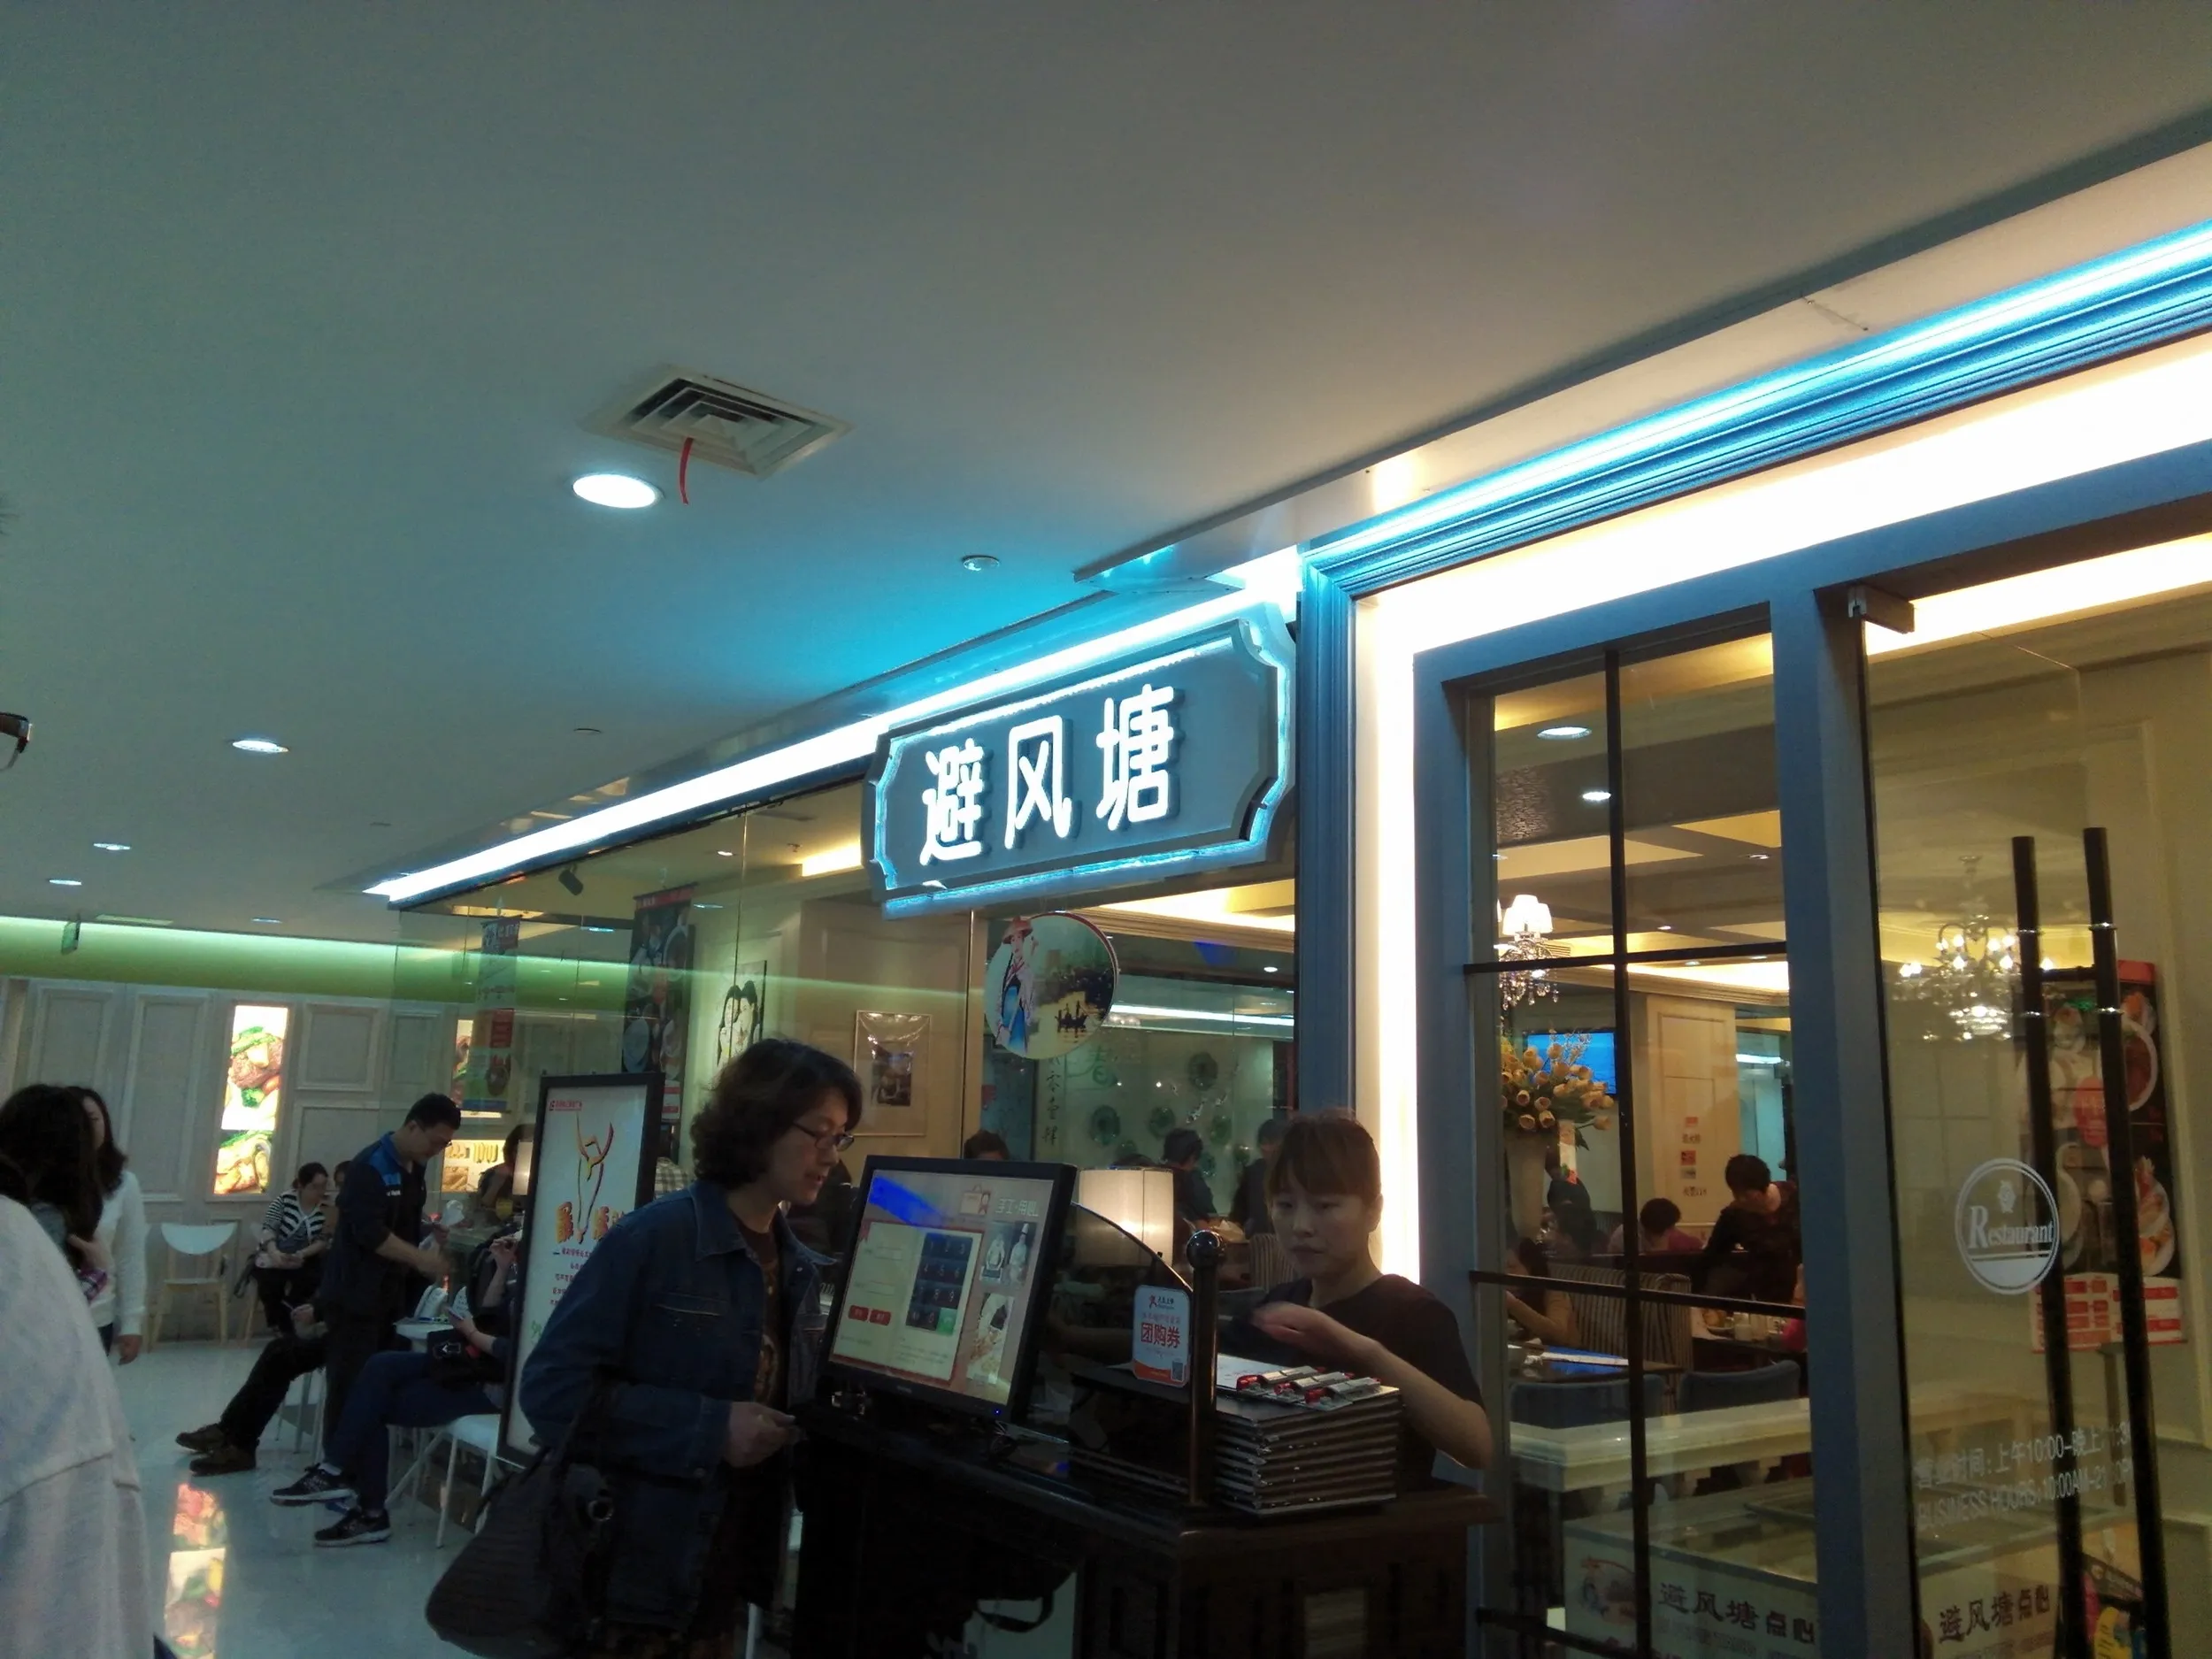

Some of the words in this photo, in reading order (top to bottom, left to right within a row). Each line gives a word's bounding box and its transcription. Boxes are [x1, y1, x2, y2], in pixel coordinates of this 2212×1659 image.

[919, 683, 1176, 866] 避风塘
[1967, 1204, 2055, 1251] Restaurant
[1141, 1322, 1181, 1349] 团购券
